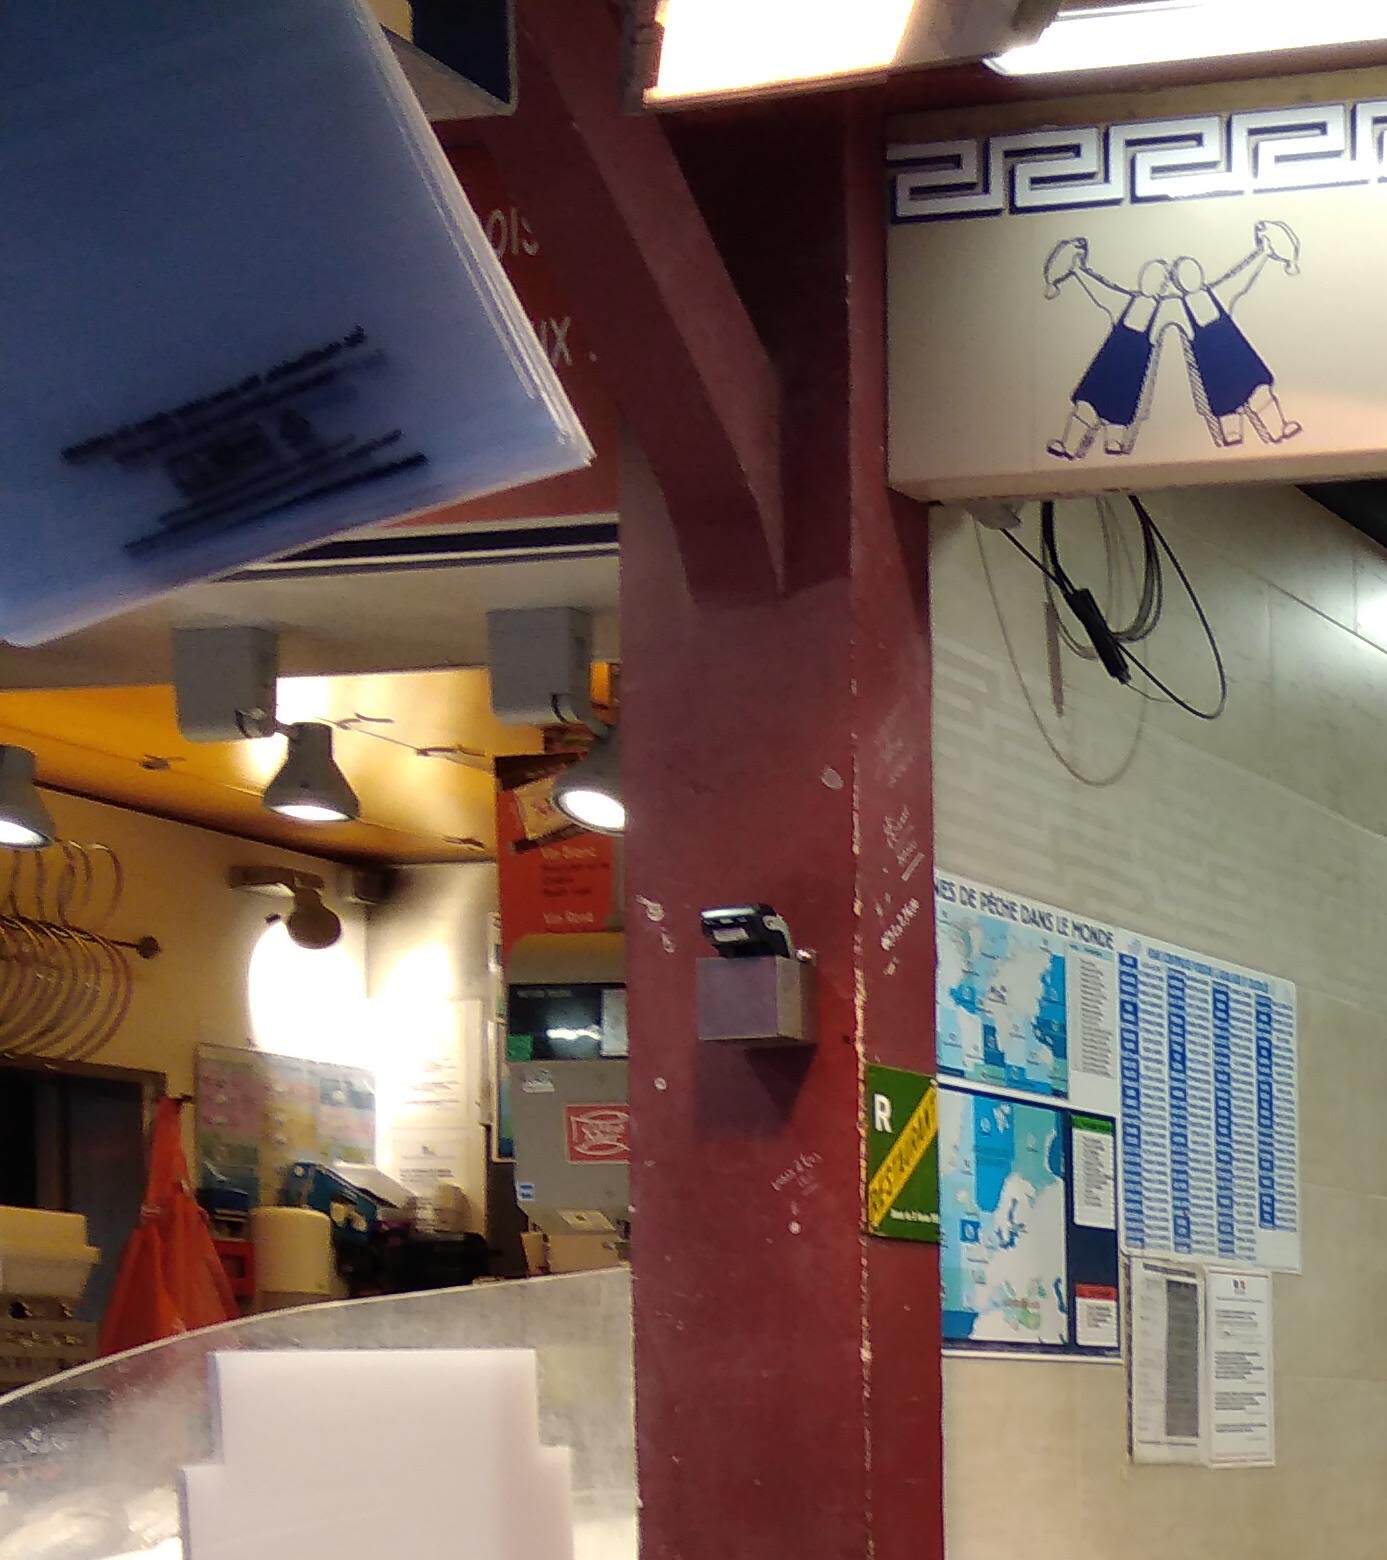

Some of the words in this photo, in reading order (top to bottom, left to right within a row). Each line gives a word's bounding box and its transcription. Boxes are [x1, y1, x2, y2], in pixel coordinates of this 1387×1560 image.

[1020, 903, 1054, 933] DANS
[1056, 916, 1071, 937] LE
[1071, 919, 1116, 951] MONDE
